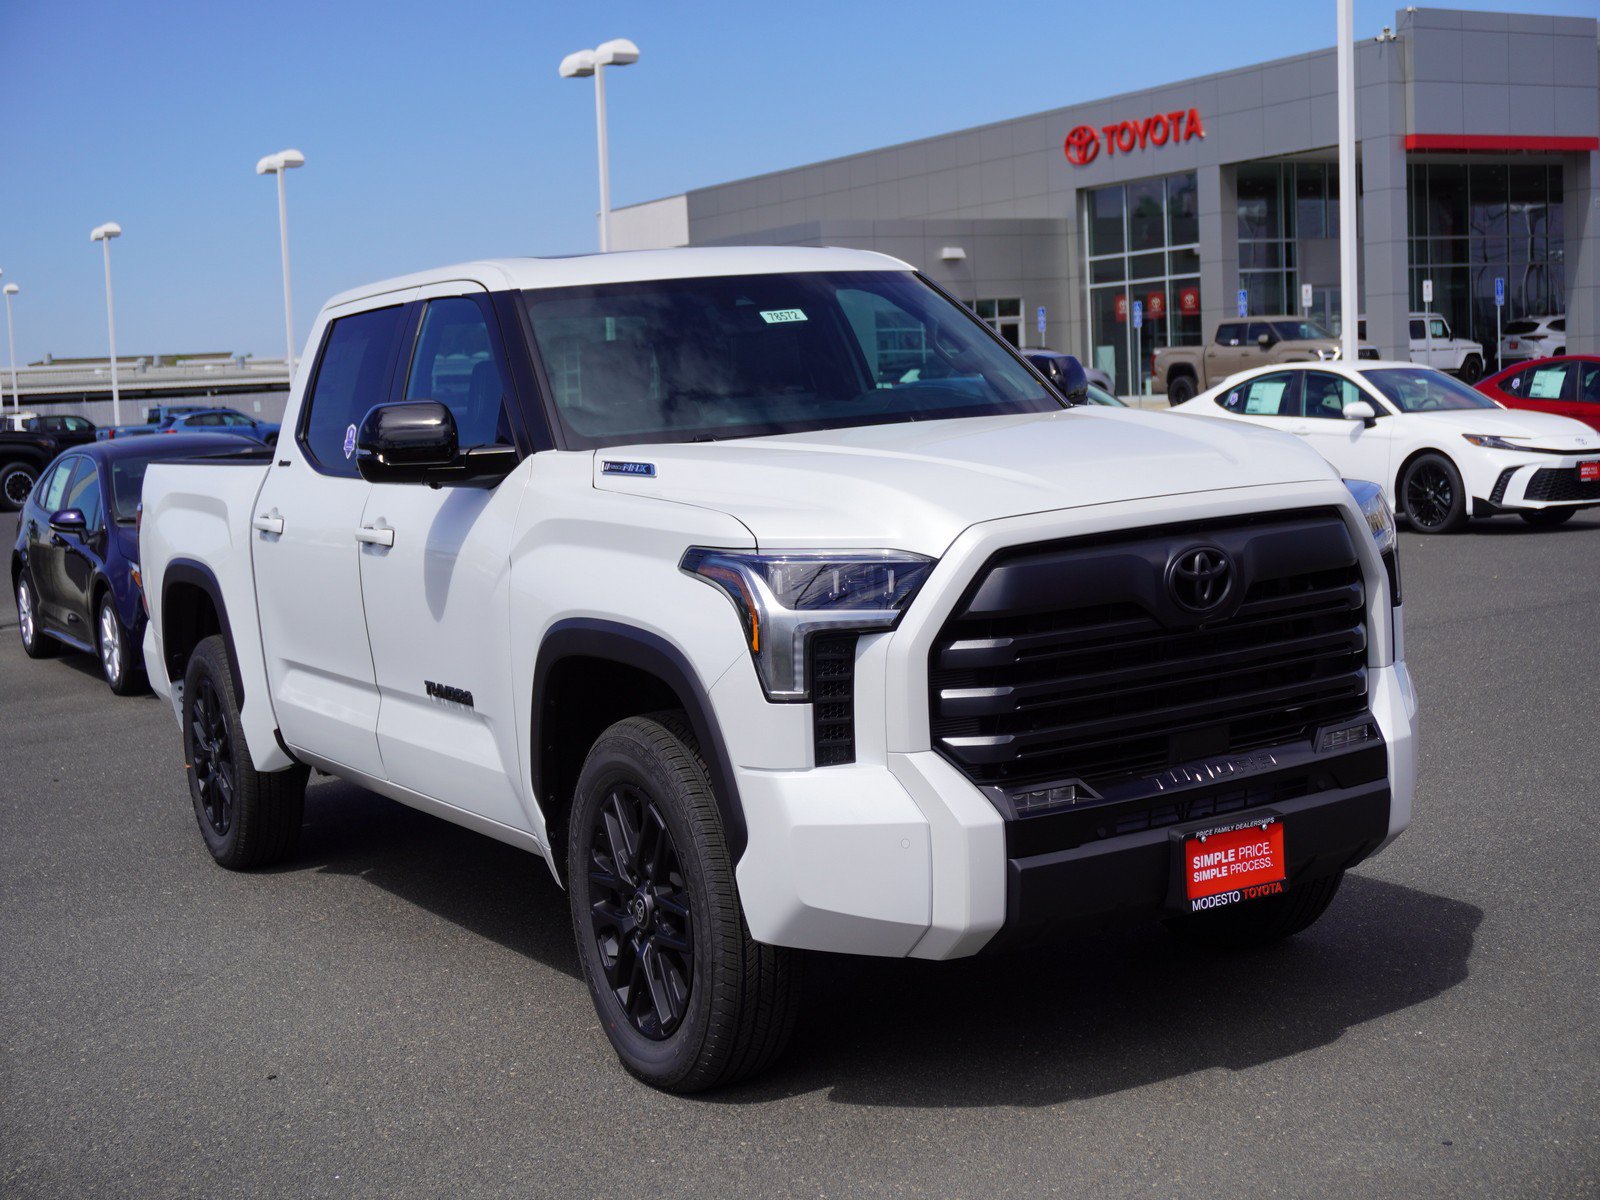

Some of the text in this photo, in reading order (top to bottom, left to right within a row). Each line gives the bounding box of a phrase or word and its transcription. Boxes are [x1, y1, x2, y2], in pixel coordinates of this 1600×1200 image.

[1101, 108, 1204, 155] TOYOTA
[767, 311, 800, 321] 78572
[424, 680, 474, 707] TUNDRA
[1195, 817, 1275, 839] PRICE FAMILY DEALERSHIPS
[1193, 842, 1273, 869] SIMPLE PRICE.
[1193, 857, 1273, 883] SIMPLE PROCESS.
[1192, 881, 1283, 911] MODESTO TOYOTA
